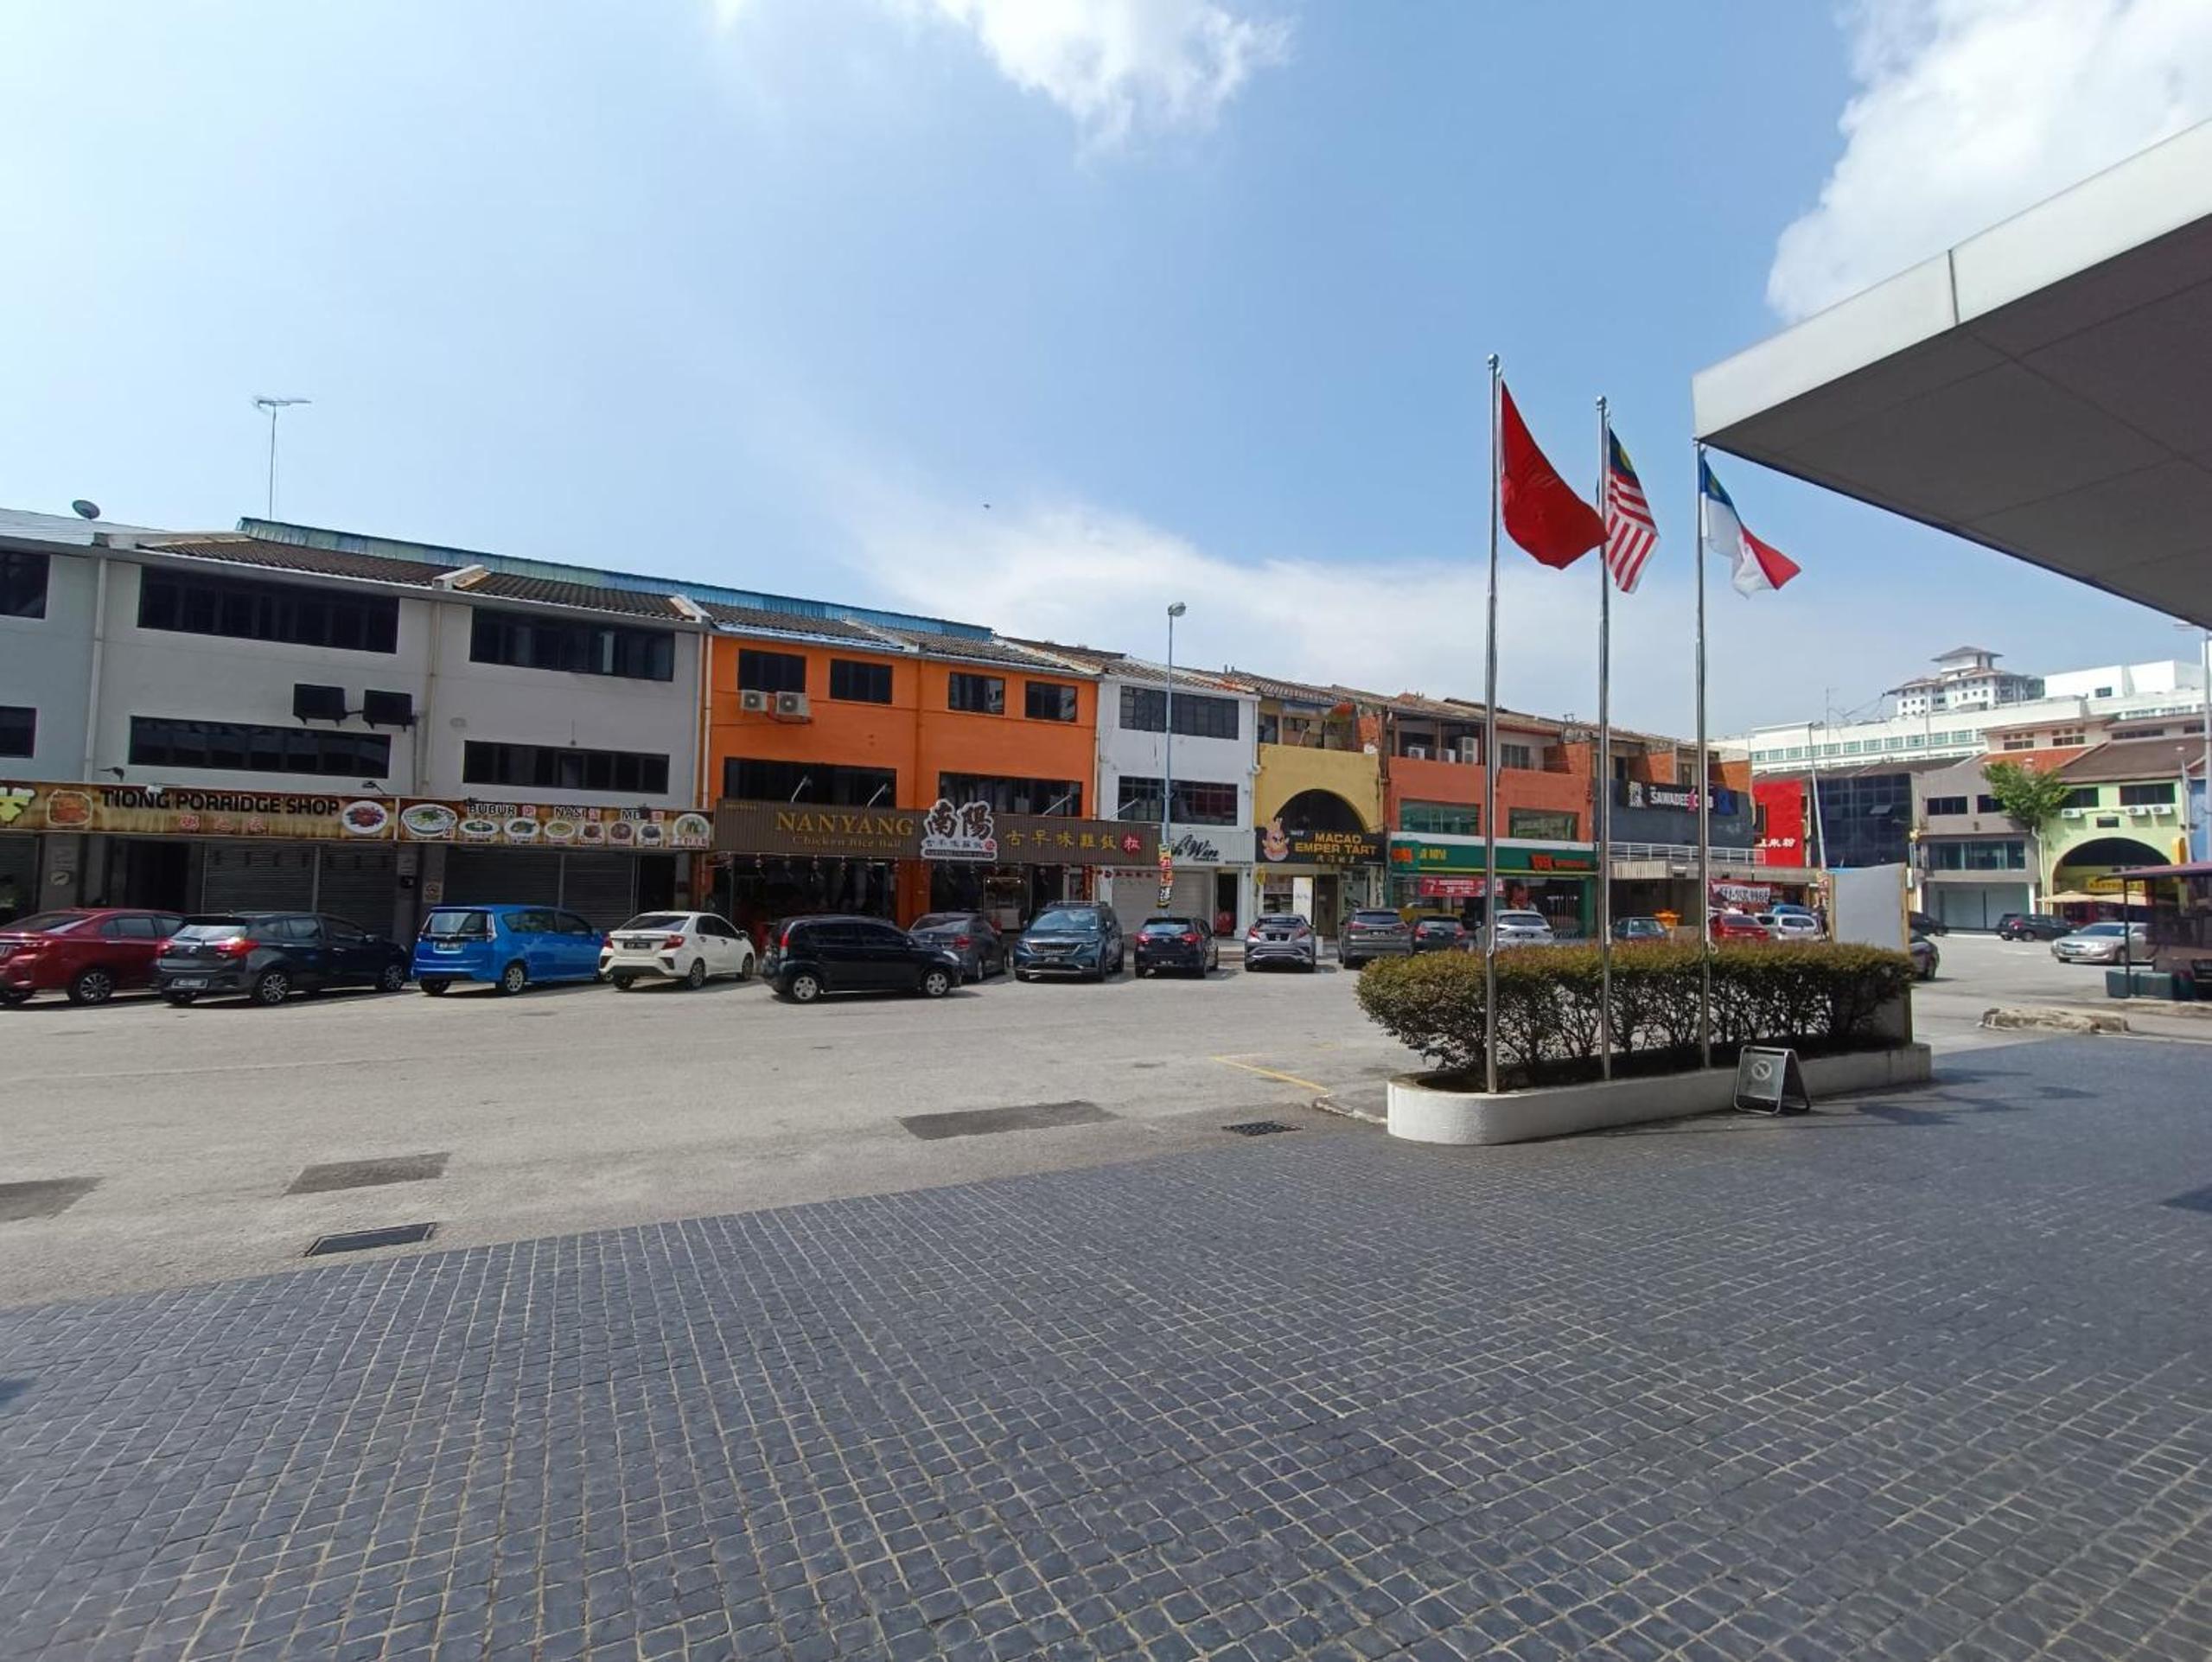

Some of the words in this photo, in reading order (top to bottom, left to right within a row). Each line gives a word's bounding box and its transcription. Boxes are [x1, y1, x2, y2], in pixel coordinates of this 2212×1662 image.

[101, 789, 169, 809] TIONG
[175, 793, 281, 814] PORRIDGE
[285, 797, 340, 816] SHOP
[468, 804, 518, 817] BUBUR
[554, 806, 587, 818] NASI
[776, 812, 914, 836] NANYANG
[1343, 844, 1379, 856] TART
